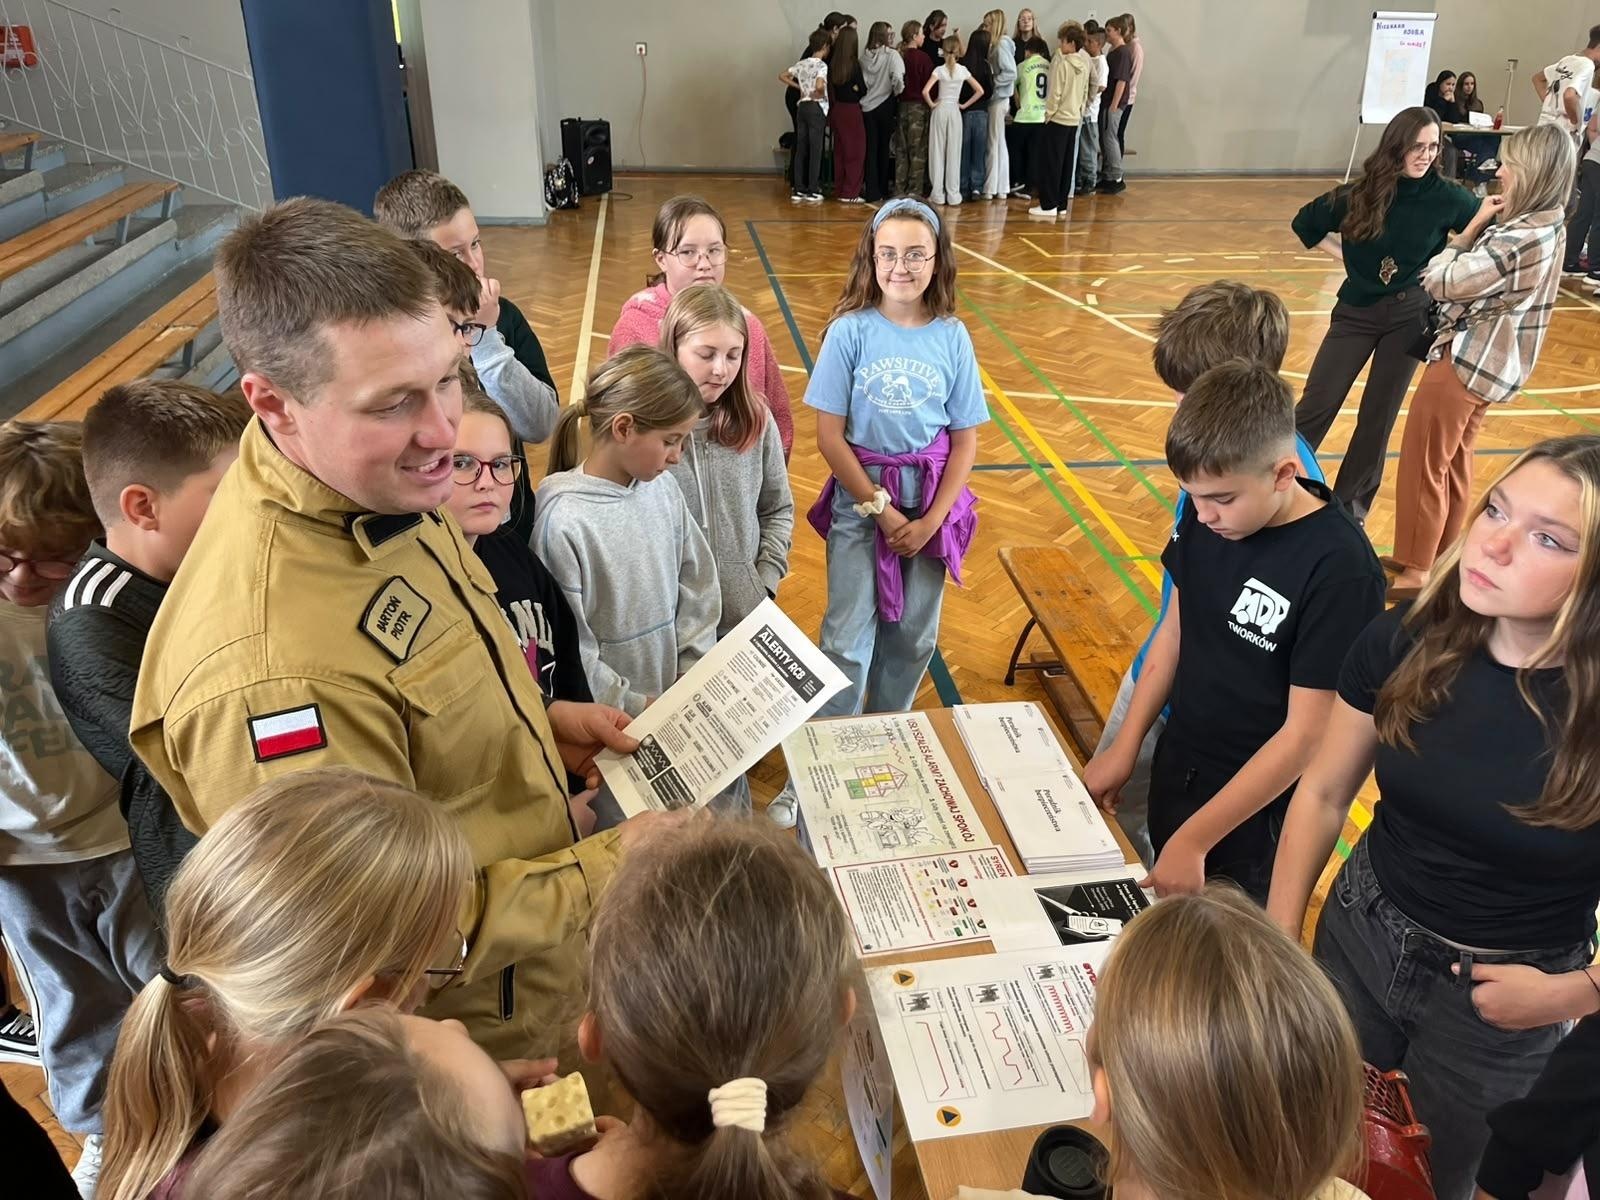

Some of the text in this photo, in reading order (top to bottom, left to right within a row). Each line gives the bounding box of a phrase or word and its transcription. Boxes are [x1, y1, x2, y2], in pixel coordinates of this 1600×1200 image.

[1036, 73, 1048, 98] 9
[860, 357, 940, 387] PAWSITIVE
[391, 610, 412, 640] PIOTR
[1227, 620, 1278, 652] TWORKÓW
[758, 631, 792, 664] ALERTY
[788, 662, 806, 680] RCB
[1006, 716, 1022, 738] Poradnik
[935, 776, 960, 816] ZACHOWAJ
[952, 814, 975, 842] SPOKÓJ
[1034, 789, 1062, 832] bezpieczeństwa
[1044, 789, 1062, 814] Poradnik
